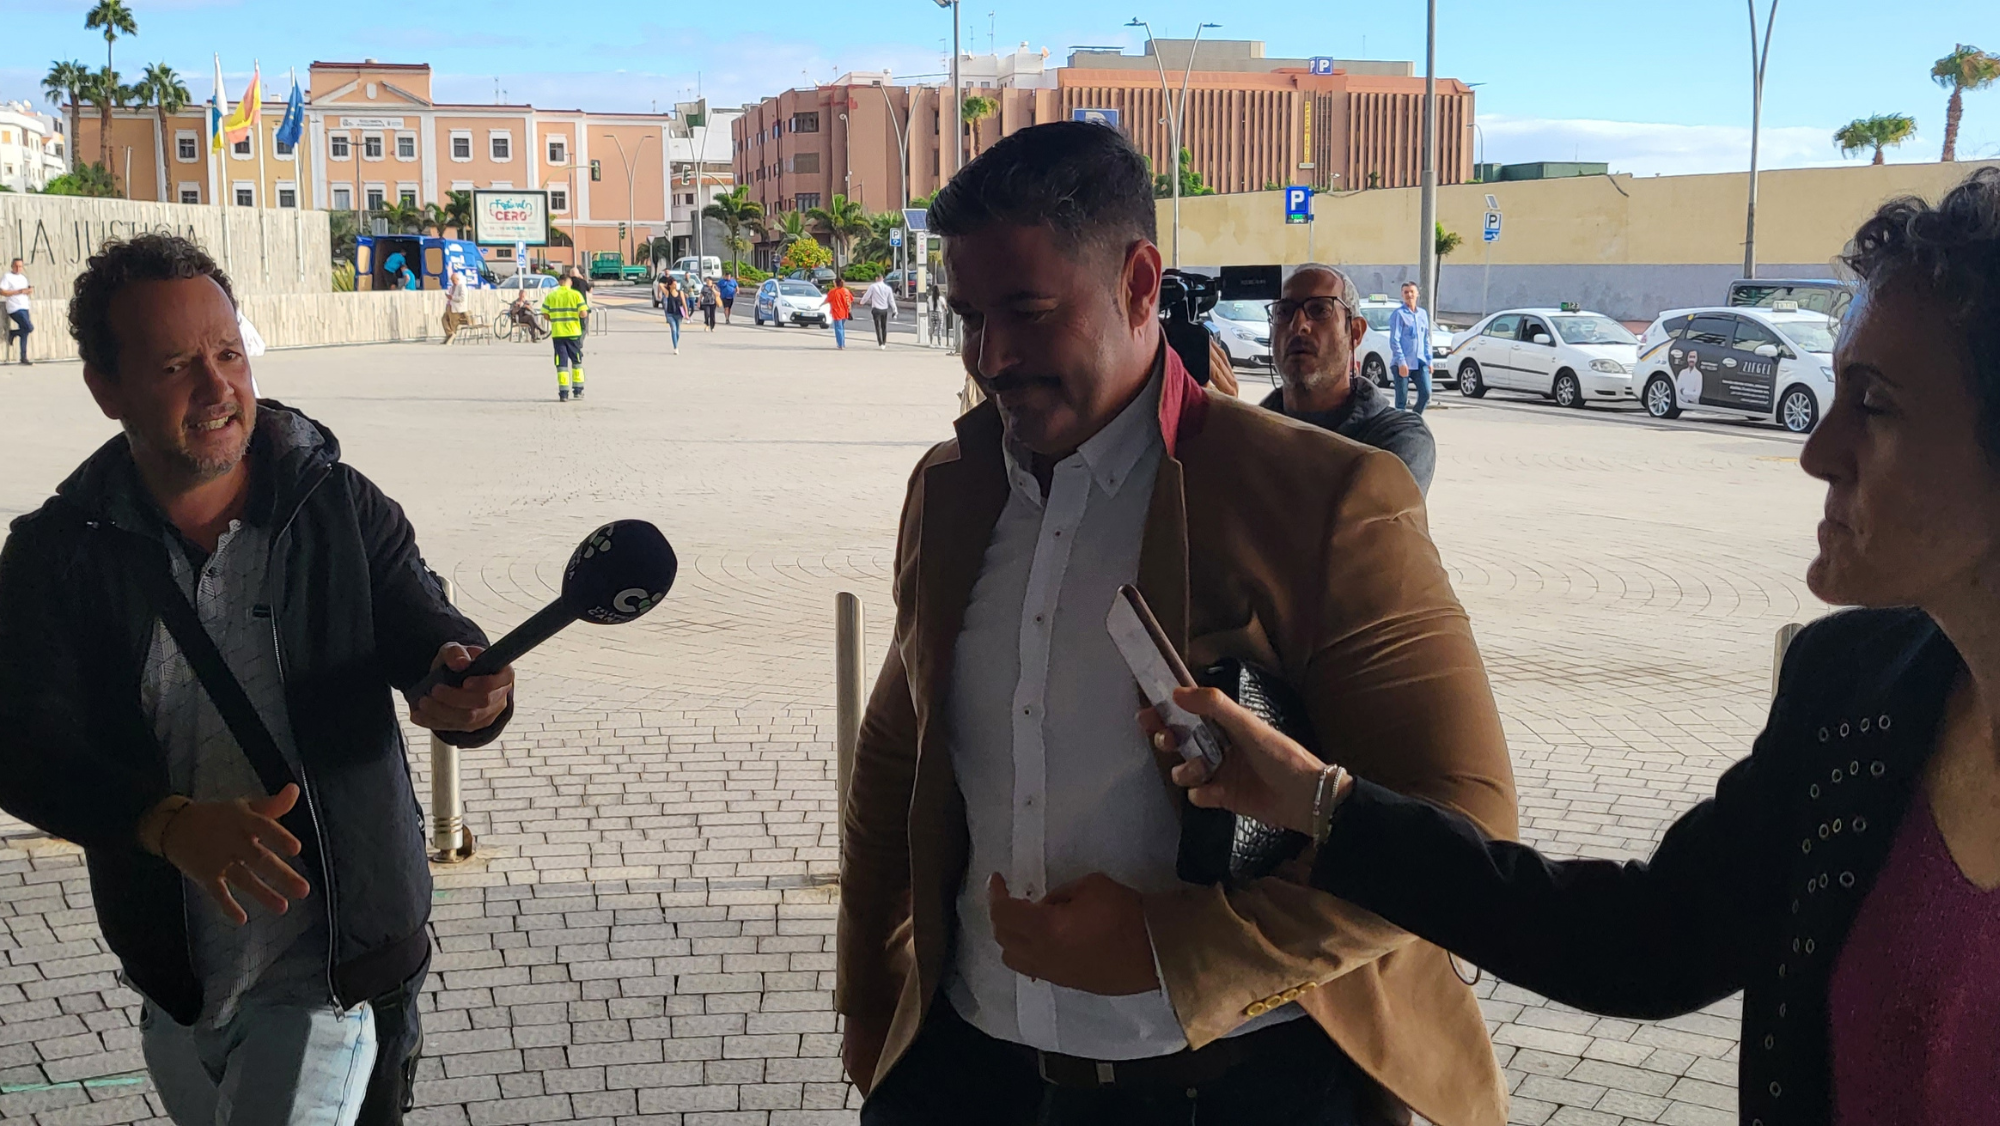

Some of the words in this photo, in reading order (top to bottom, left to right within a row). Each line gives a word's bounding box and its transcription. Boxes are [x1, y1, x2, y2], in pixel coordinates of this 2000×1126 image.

[1319, 60, 1330, 72] P
[1291, 190, 1305, 211] P
[495, 211, 527, 221] CERO
[1489, 215, 1498, 228] P
[893, 230, 899, 238] P
